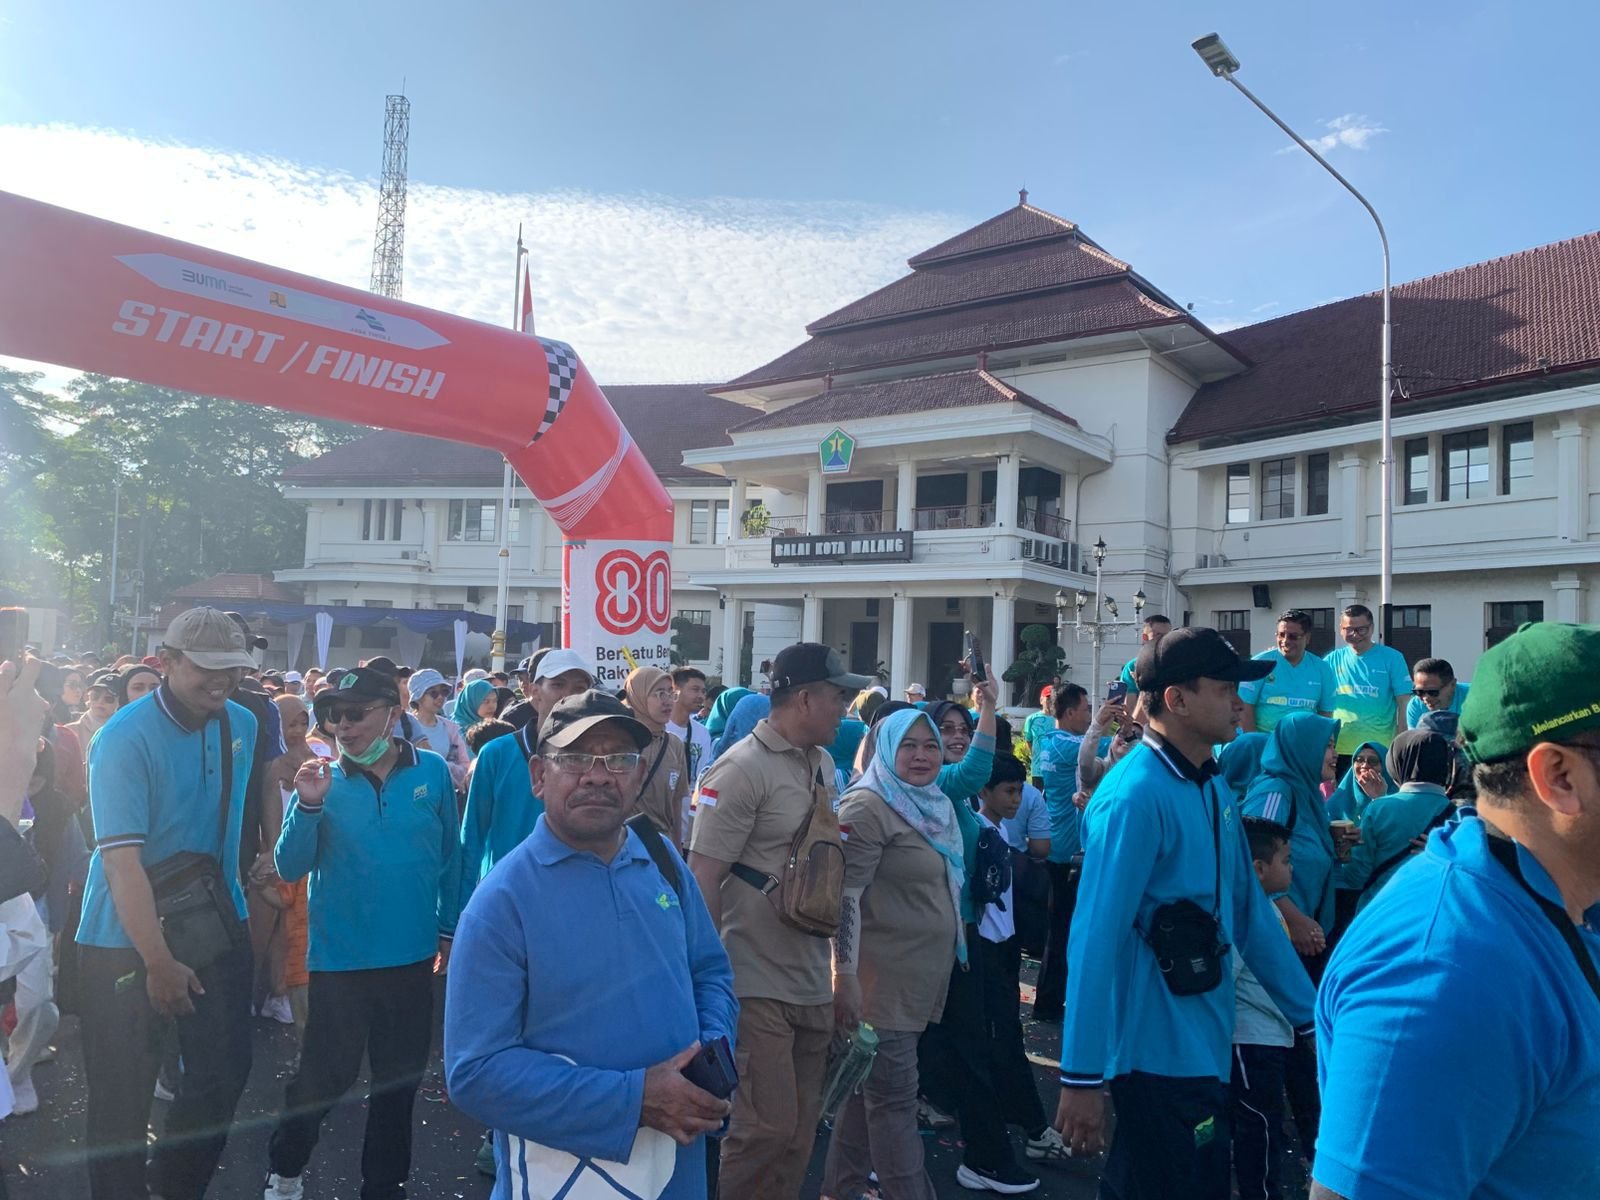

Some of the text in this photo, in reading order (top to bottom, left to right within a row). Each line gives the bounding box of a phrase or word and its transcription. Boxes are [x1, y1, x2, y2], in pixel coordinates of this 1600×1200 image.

[112, 299, 446, 400] START / FINISH
[775, 539, 904, 557] BALAI KOTA MALANG
[595, 548, 671, 636] 80
[1531, 708, 1592, 735] Melancarkan
